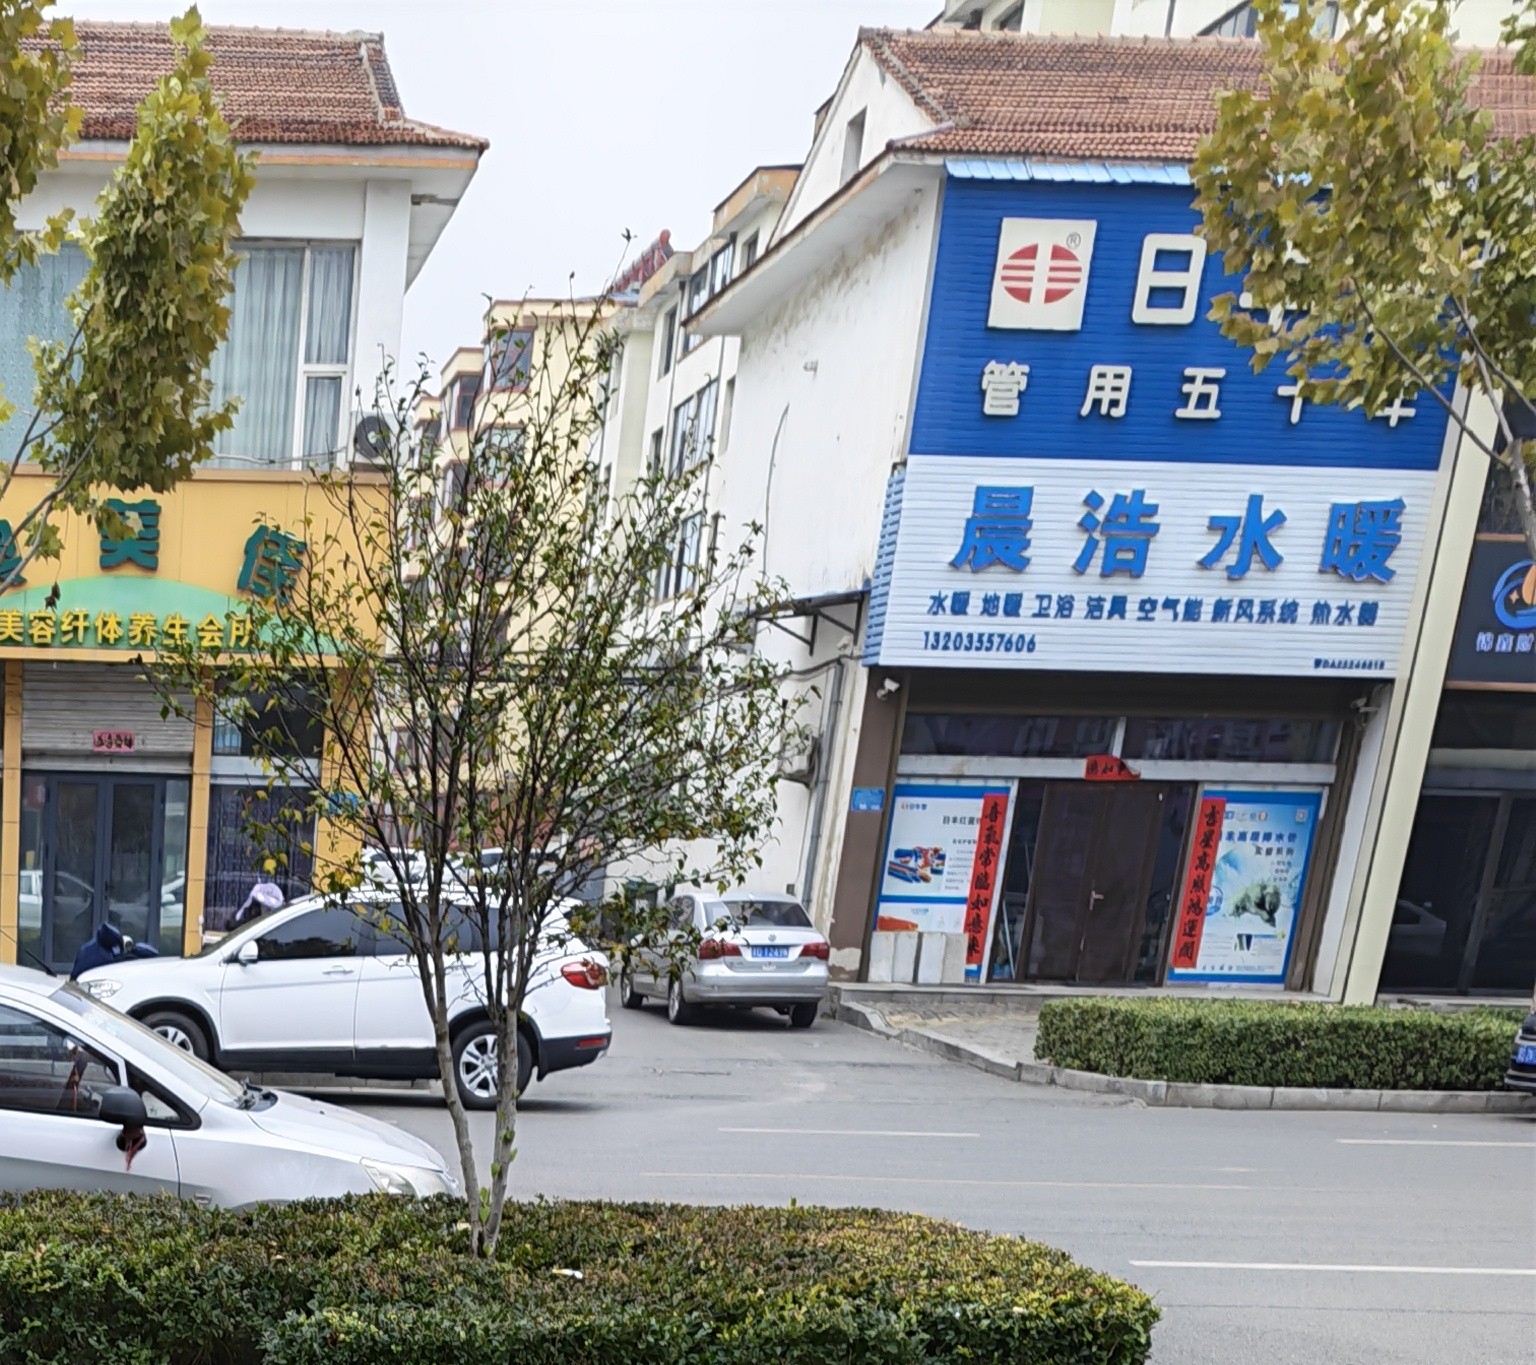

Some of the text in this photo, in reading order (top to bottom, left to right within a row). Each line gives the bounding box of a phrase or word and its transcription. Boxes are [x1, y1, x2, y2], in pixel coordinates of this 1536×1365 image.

[948, 485, 1406, 585] 晨浩水暖
[927, 590, 971, 616] 水暖
[980, 592, 1023, 618] 地暖
[1031, 594, 1075, 619] 卫浴
[1136, 596, 1203, 622] 空气能
[1212, 597, 1299, 624] 新风系统
[923, 631, 1037, 653] 13203557606
